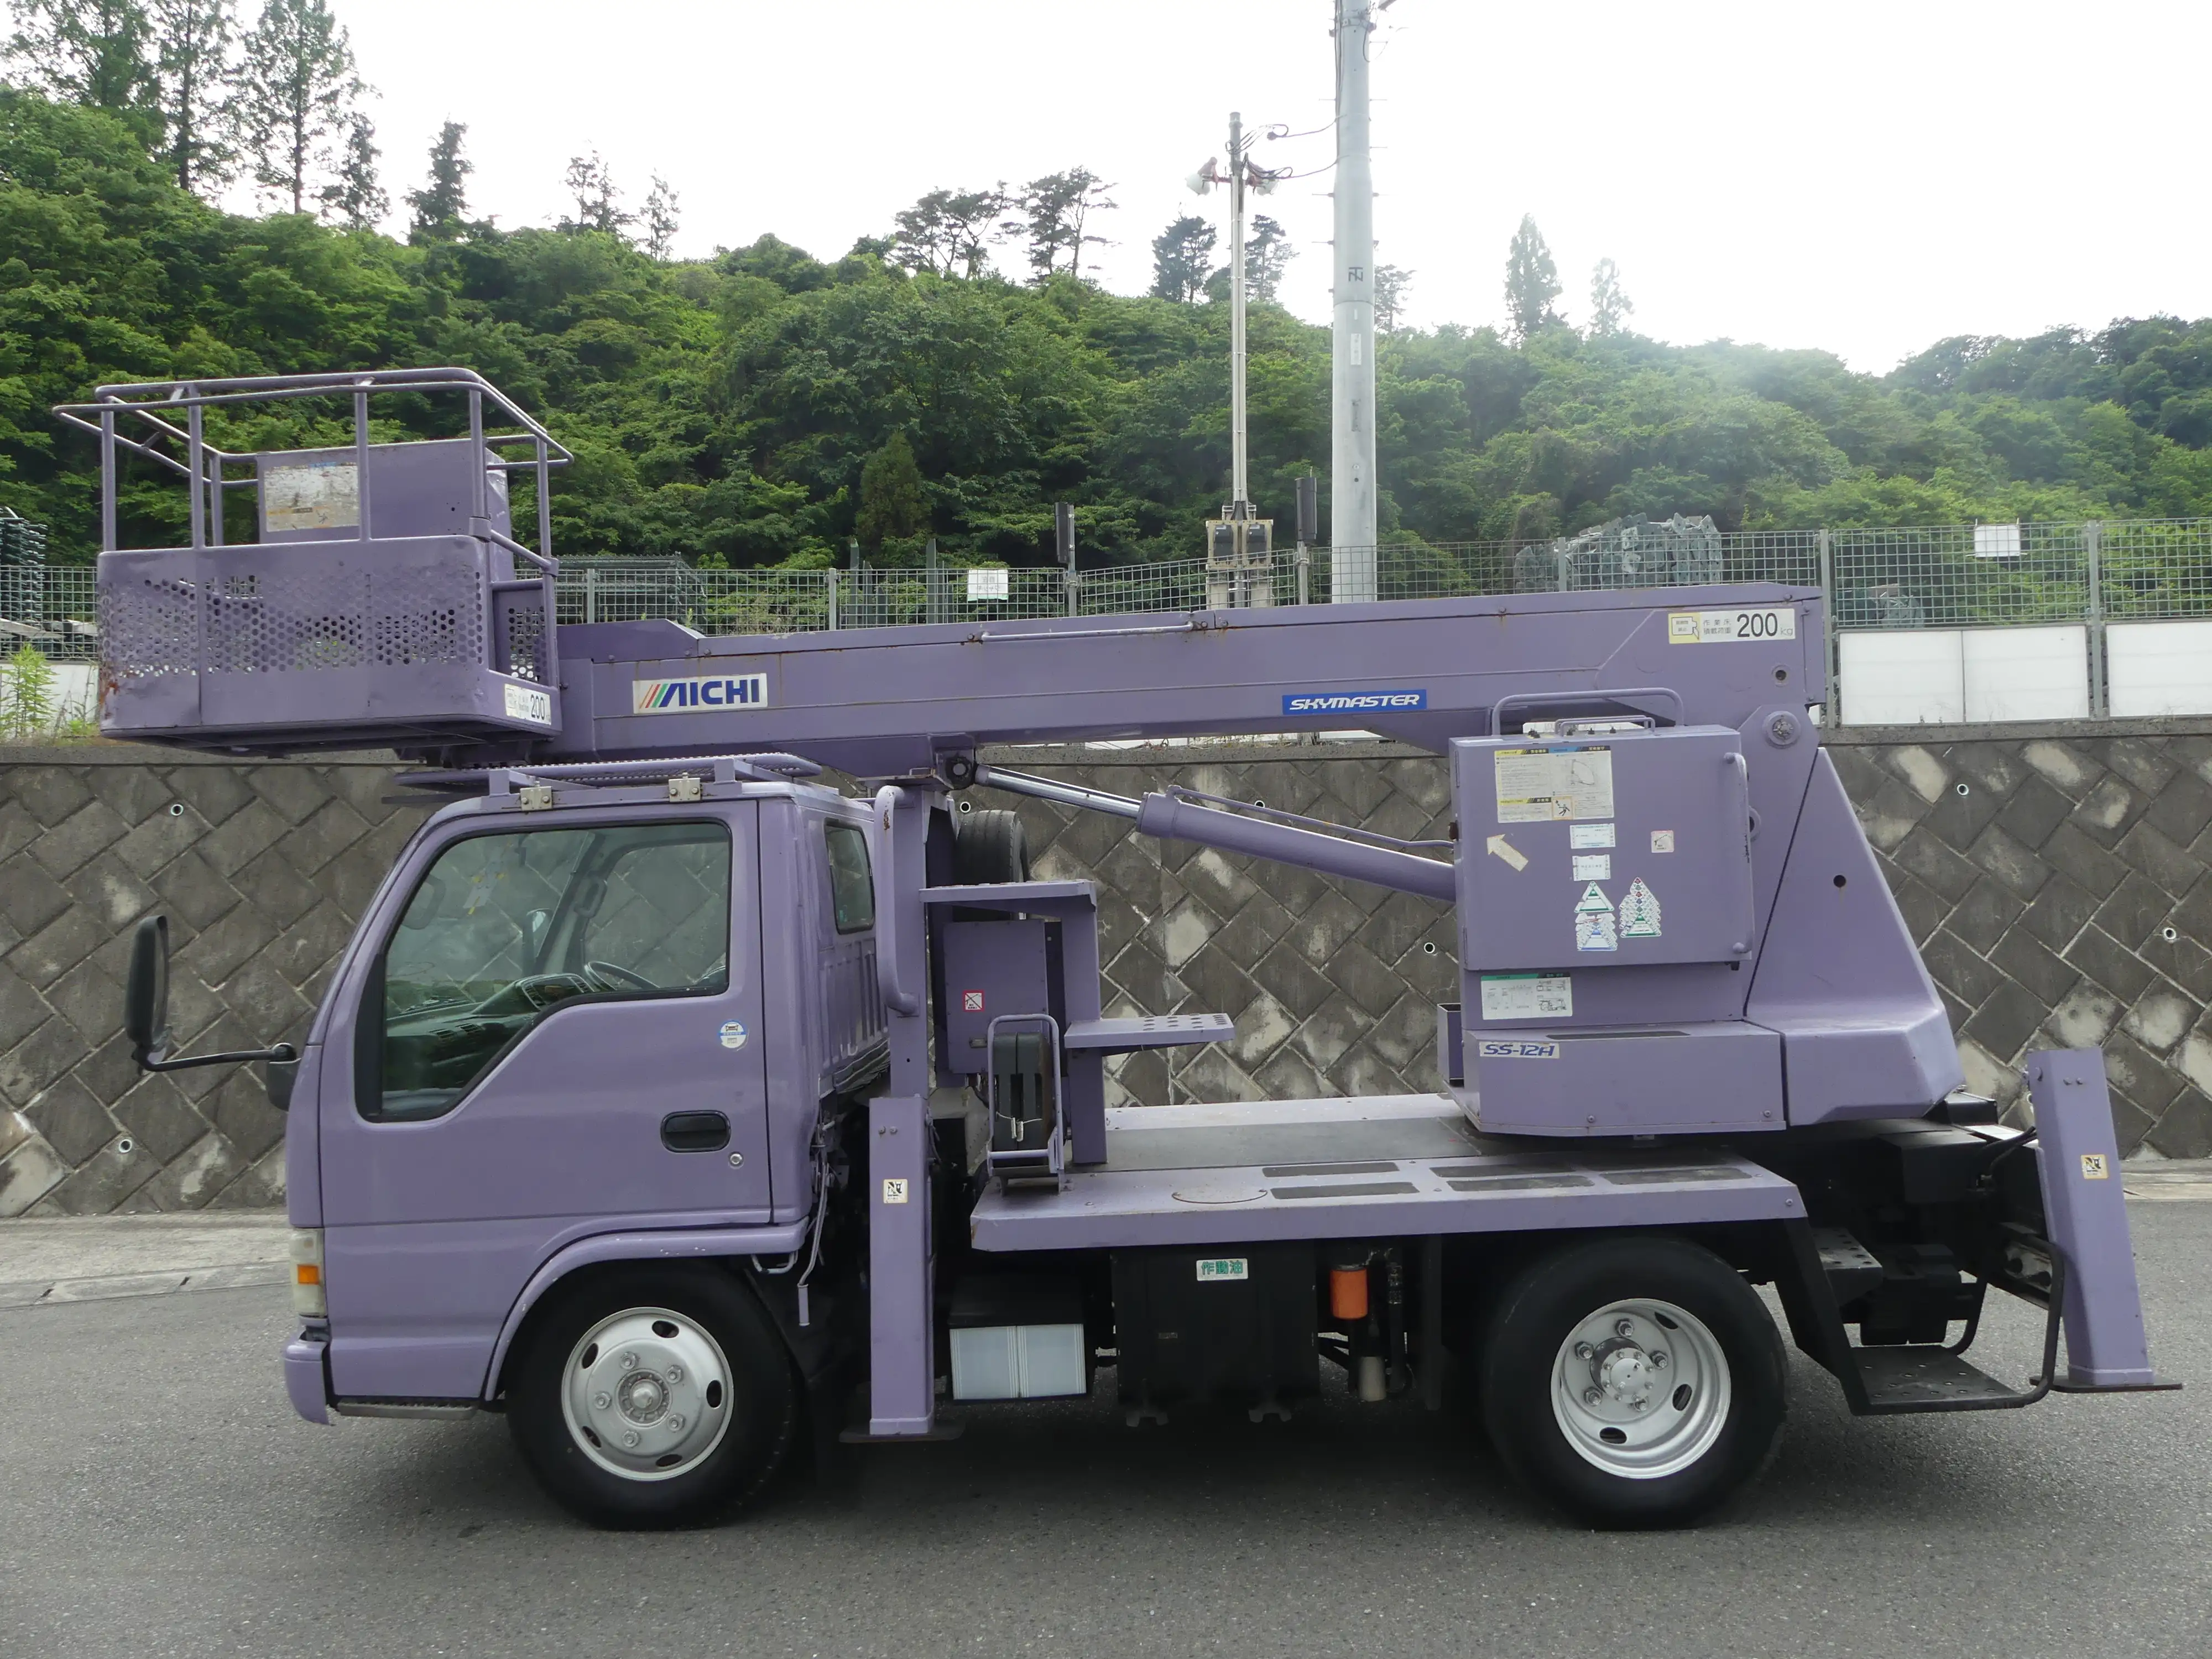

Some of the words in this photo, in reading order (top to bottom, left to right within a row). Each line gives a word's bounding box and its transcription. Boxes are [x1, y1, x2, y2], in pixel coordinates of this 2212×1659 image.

[1737, 613, 1778, 637] 200
[1780, 627, 1793, 637] kg
[659, 679, 760, 708] AICHI
[1290, 694, 1420, 710] SKYMASTER
[530, 693, 545, 720] 200
[1201, 1260, 1243, 1275] 作動油
